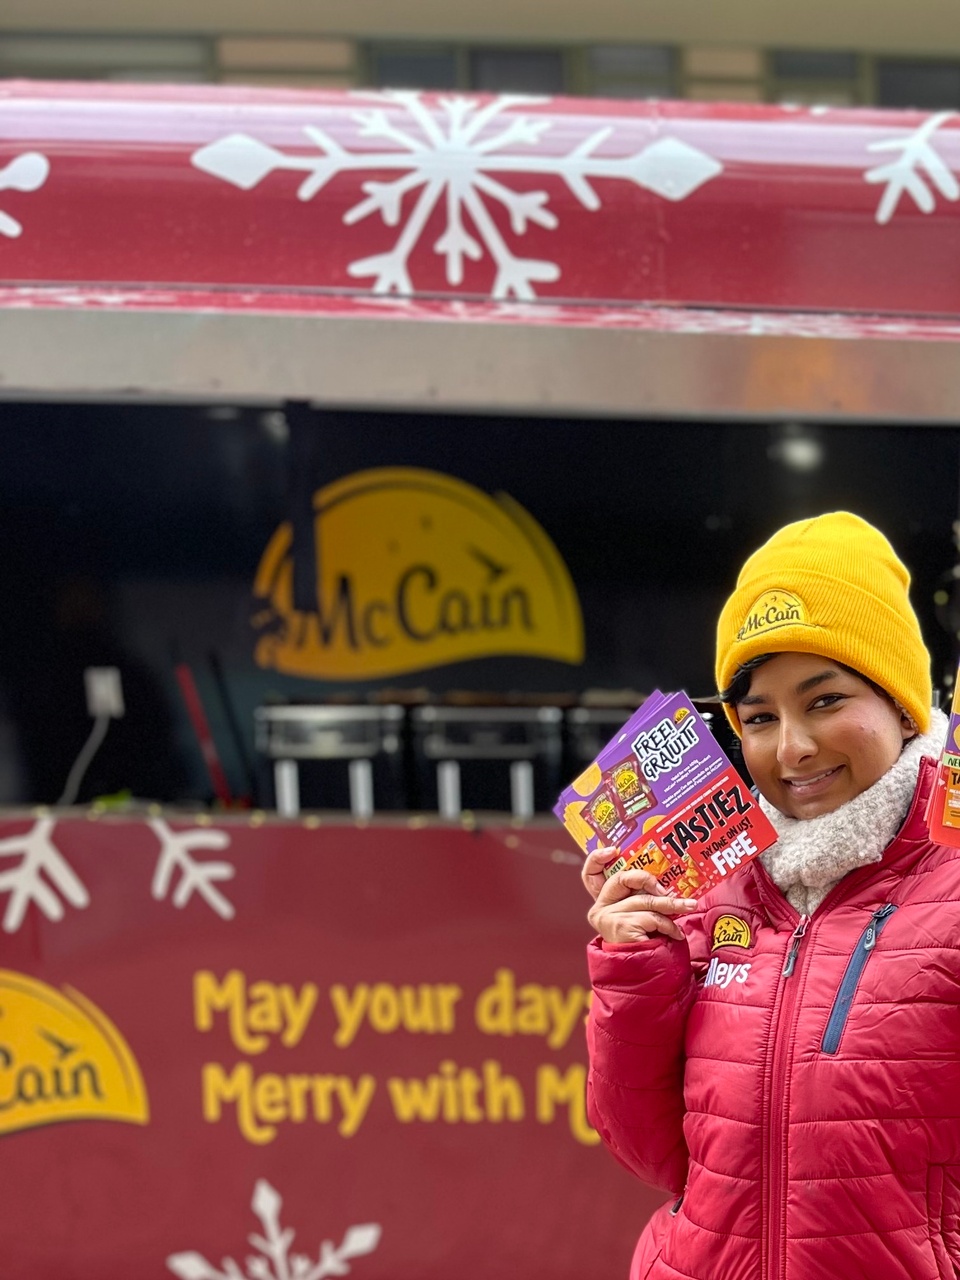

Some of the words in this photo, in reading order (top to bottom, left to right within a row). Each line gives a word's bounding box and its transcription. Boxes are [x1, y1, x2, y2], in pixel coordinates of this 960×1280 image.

[744, 606, 801, 635] McCain
[633, 719, 677, 760] FREE!
[643, 718, 698, 779] GRATUIT!
[700, 846, 713, 860] TRY
[712, 836, 728, 852] ONE
[726, 826, 738, 839] ON
[737, 816, 754, 832] US!
[710, 830, 758, 876] FREE
[194, 969, 318, 1055] May
[331, 981, 462, 1048] your
[475, 967, 592, 1049] day
[203, 1061, 375, 1145] Merry
[389, 1059, 524, 1123] with
